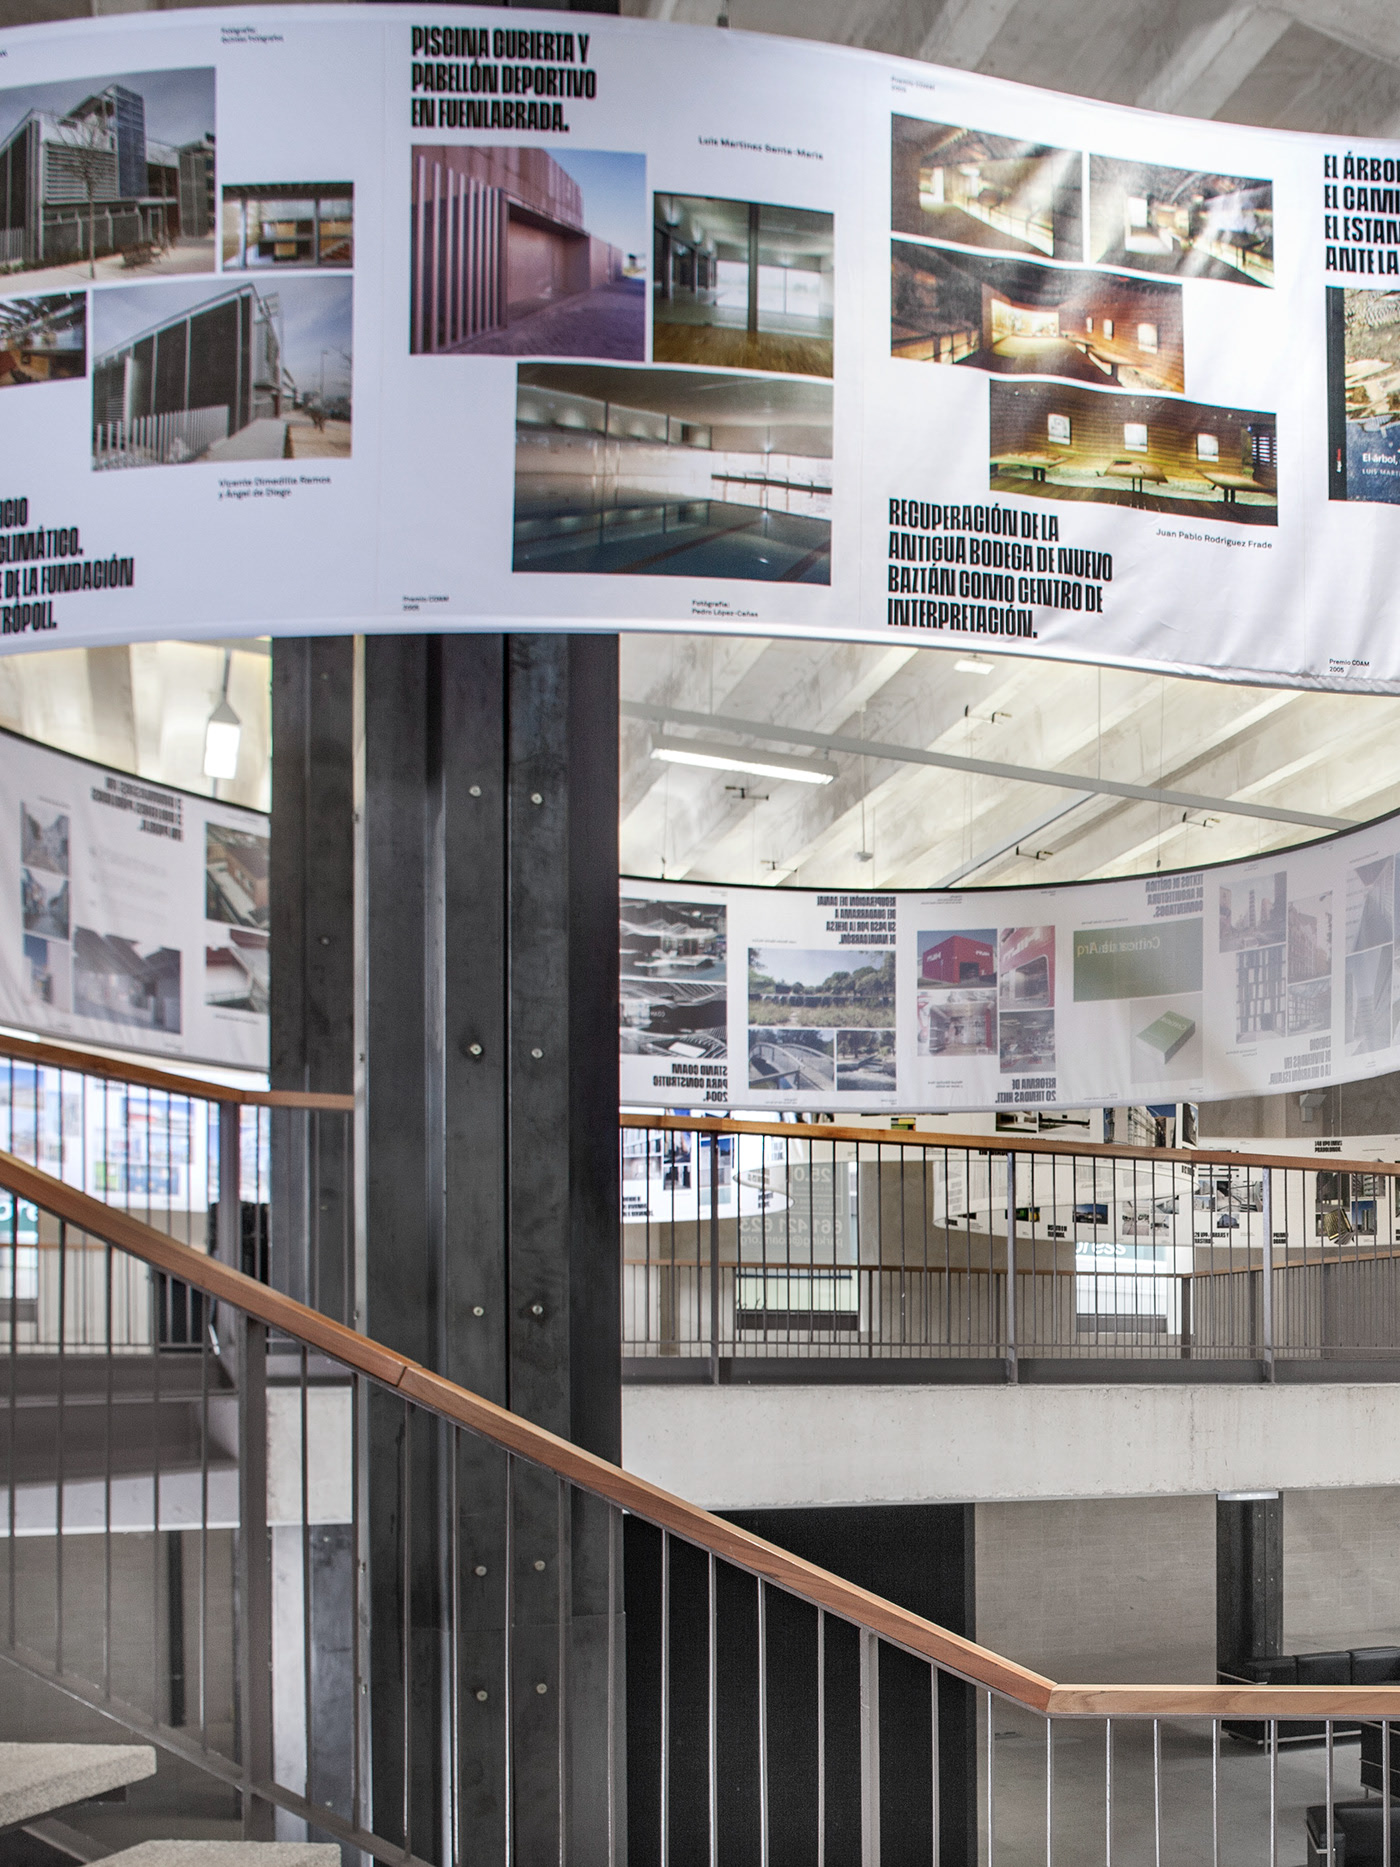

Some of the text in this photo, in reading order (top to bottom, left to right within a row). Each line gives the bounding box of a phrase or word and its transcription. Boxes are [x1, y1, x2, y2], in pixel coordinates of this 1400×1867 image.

[411, 26, 590, 64] PISCINA CUBIERTA Y
[411, 58, 597, 100] PABELLÓN DEPORTIVO
[411, 98, 570, 132] EN FUENLABRADA.
[1324, 154, 1338, 179] EL
[1324, 185, 1338, 209] EL
[1324, 215, 1339, 240] EL
[1326, 246, 1374, 274] ANTE
[1378, 250, 1398, 275] LA
[1362, 453, 1370, 462] El
[889, 498, 1059, 542] RECUPERACIÓN DE LA
[889, 531, 1112, 582] ANTIGUA BODEGA DE NUEVO
[1156, 528, 1272, 549] Juan Pablo Frade
[5, 553, 134, 598] DE LA FUNDACIÓN
[888, 563, 1103, 613] BAZTÁN COMO CENTRO DE
[888, 598, 1038, 638] INTERPRETACIÓN.
